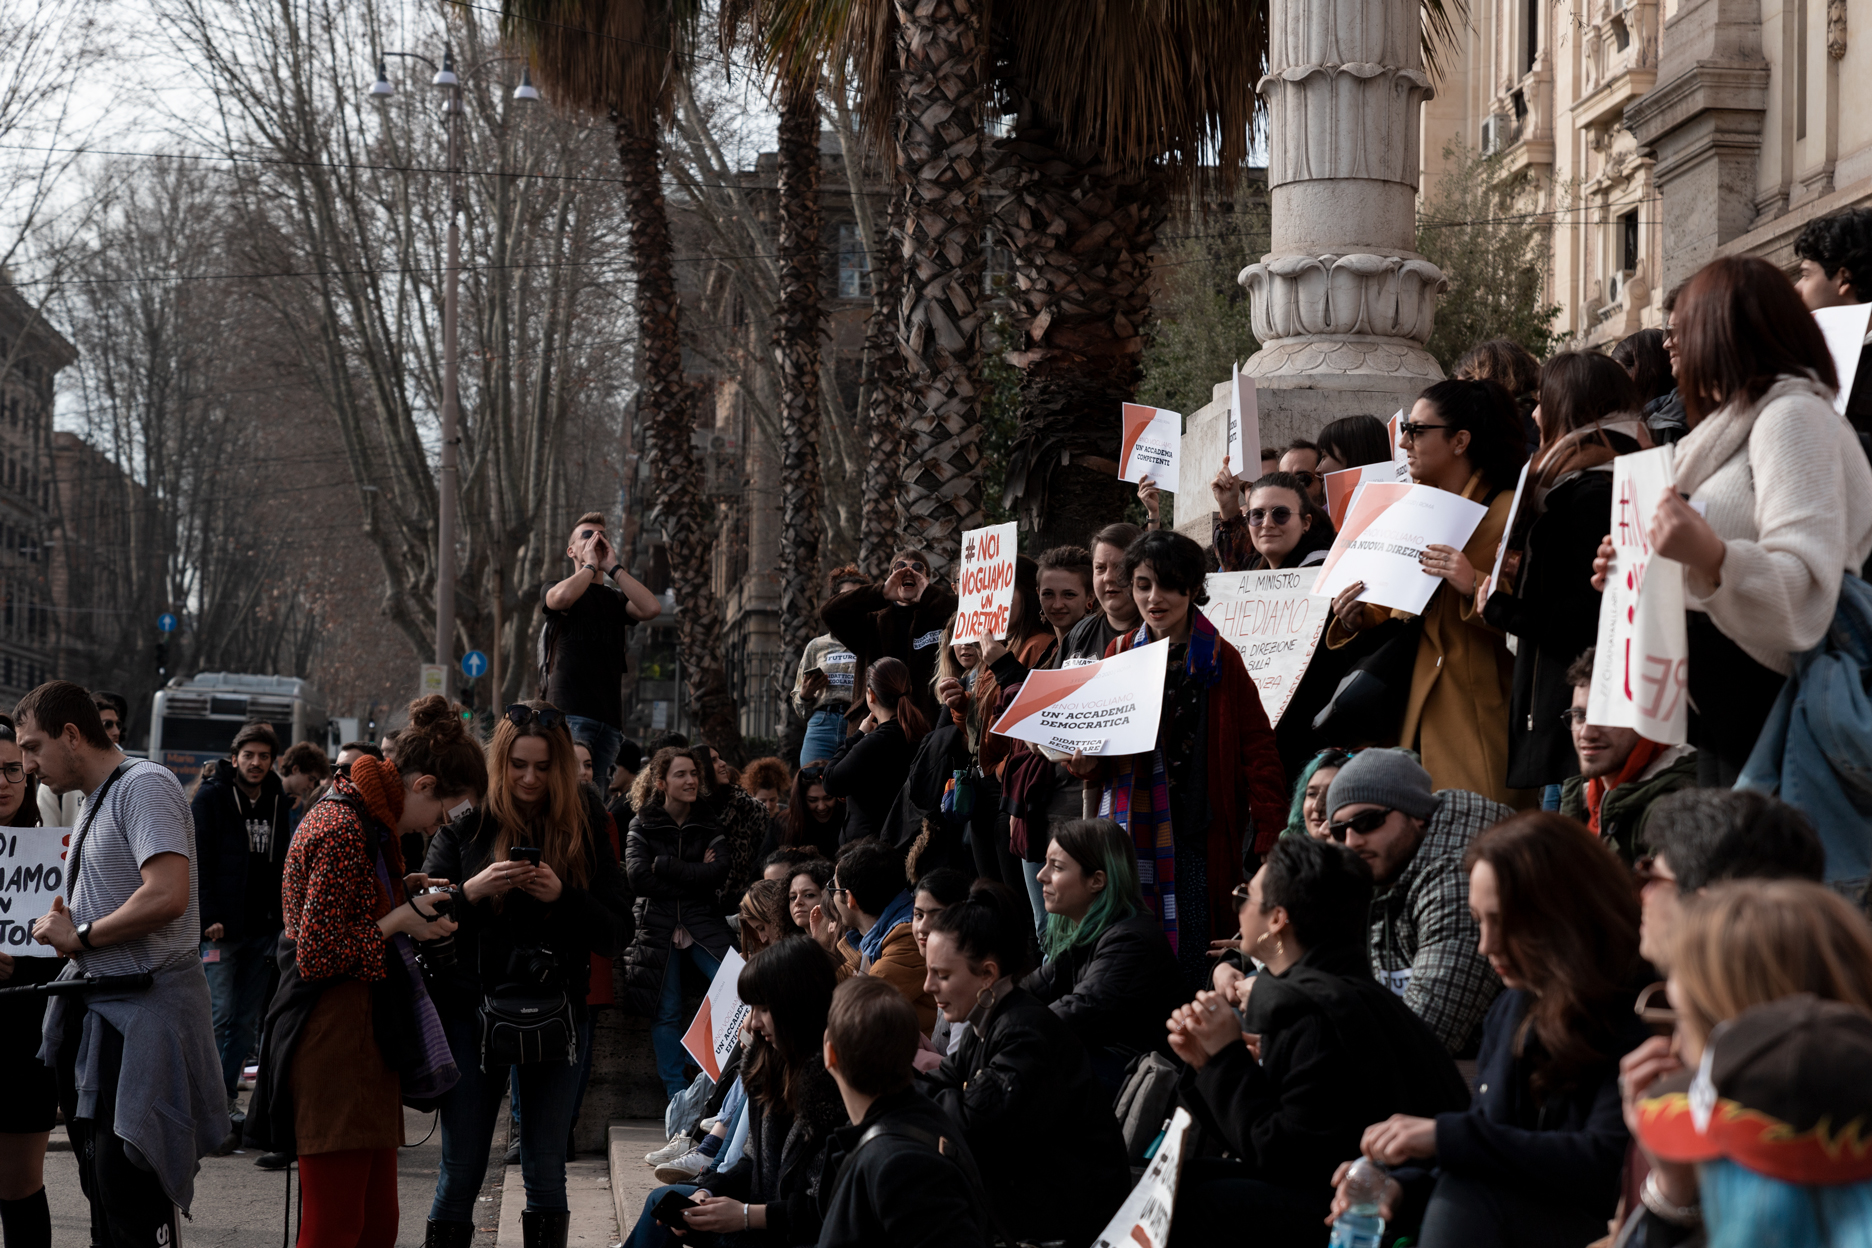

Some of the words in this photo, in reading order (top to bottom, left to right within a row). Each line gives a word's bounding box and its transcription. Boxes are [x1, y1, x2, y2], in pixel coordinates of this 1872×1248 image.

[1136, 453, 1171, 467] COMPETENTE
[1144, 445, 1173, 459] ACCADEMIA
[1340, 538, 1357, 549] UNA
[1357, 540, 1385, 552] NUOVA
[1379, 529, 1425, 546] VOGLIAMO
[961, 559, 1014, 598] VOGLIAMO
[1237, 575, 1251, 595] AL
[1255, 572, 1301, 592] MINISTRO
[981, 592, 994, 610] UN
[955, 603, 1009, 640] DIRETTORE
[1249, 638, 1298, 658] DIREZIONE
[1247, 657, 1272, 671] SULLA
[1051, 701, 1079, 711] #NOI
[1081, 692, 1134, 710] VOGLIAMO
[1040, 710, 1064, 720] UN'
[1065, 703, 1136, 720] ACCADEMIA
[1039, 716, 1130, 730] DEMOCRATICA
[1048, 740, 1101, 752] REGOARE
[1052, 736, 1102, 746] DIDATTICA
[722, 996, 741, 1027] VOGLIAM
